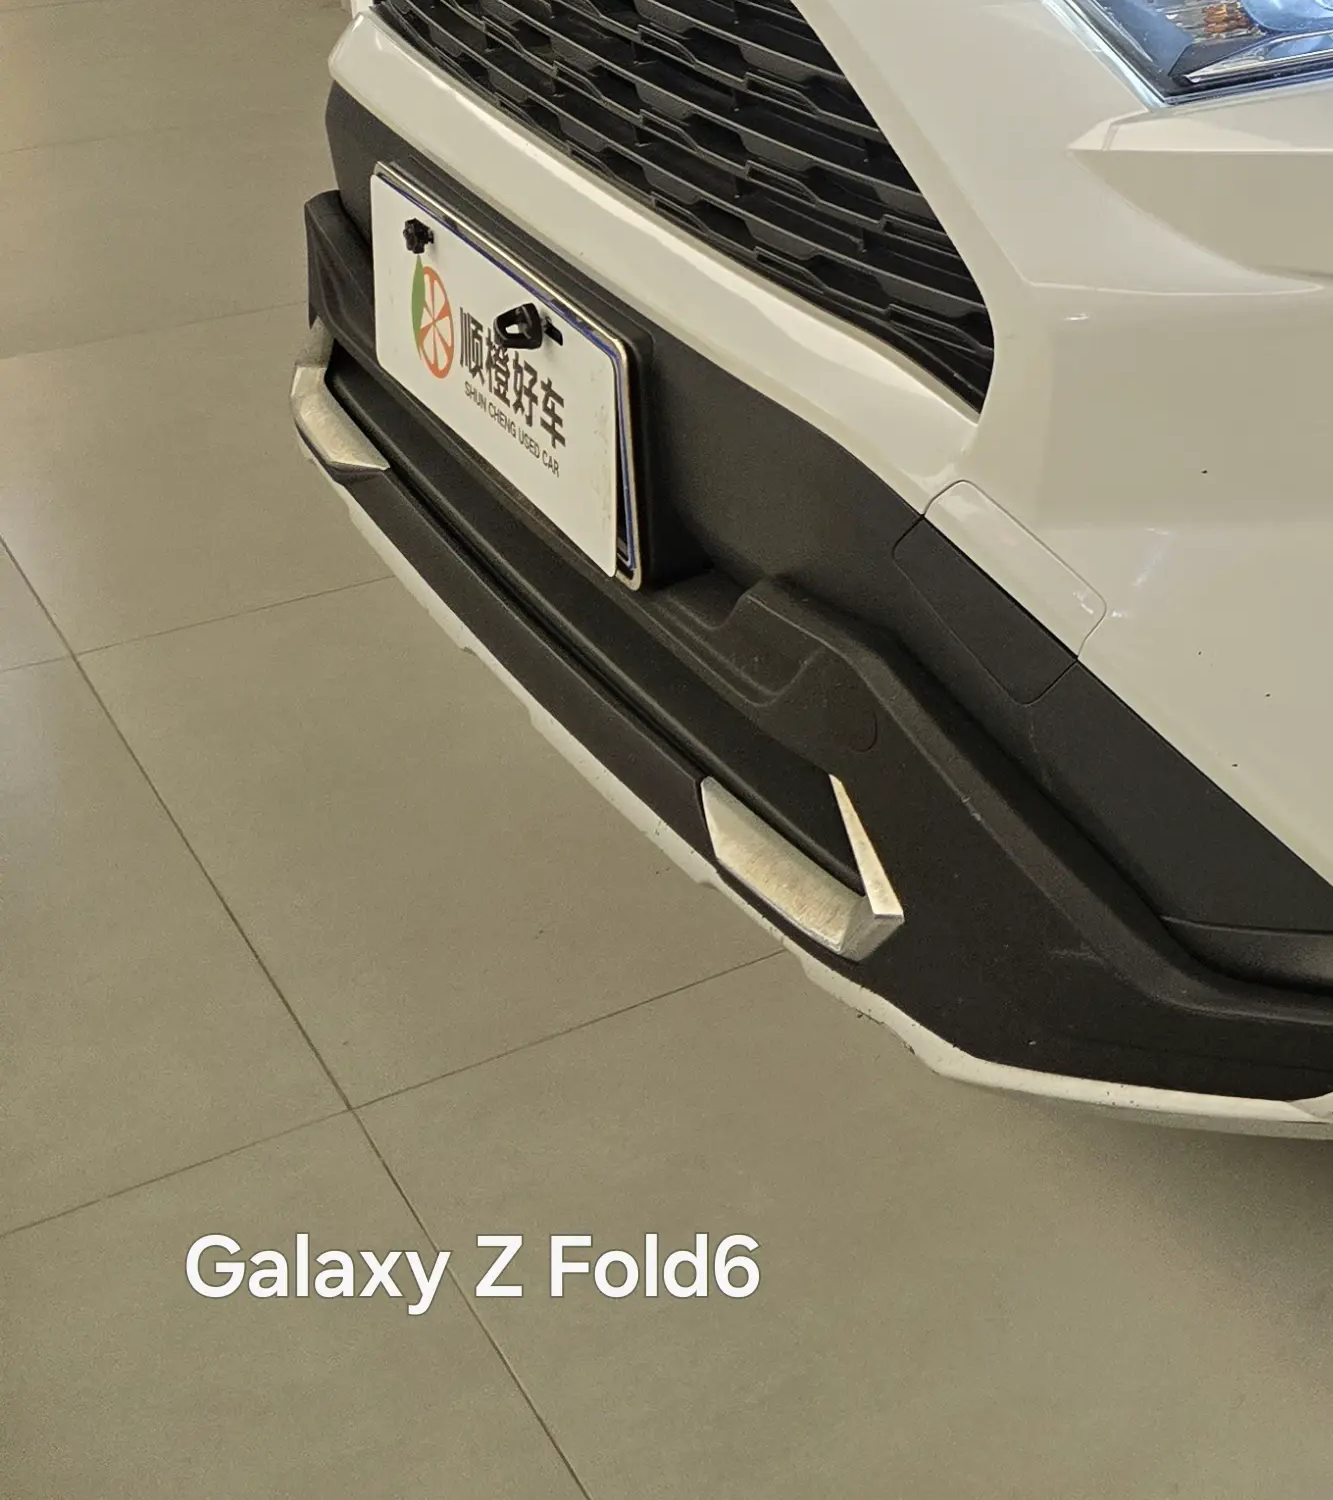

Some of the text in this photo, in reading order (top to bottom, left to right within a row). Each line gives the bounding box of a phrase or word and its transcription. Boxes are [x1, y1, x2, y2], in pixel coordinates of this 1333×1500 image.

[459, 306, 567, 450] 顺橙好车
[464, 380, 561, 478] SHUN CHENG USED CAR
